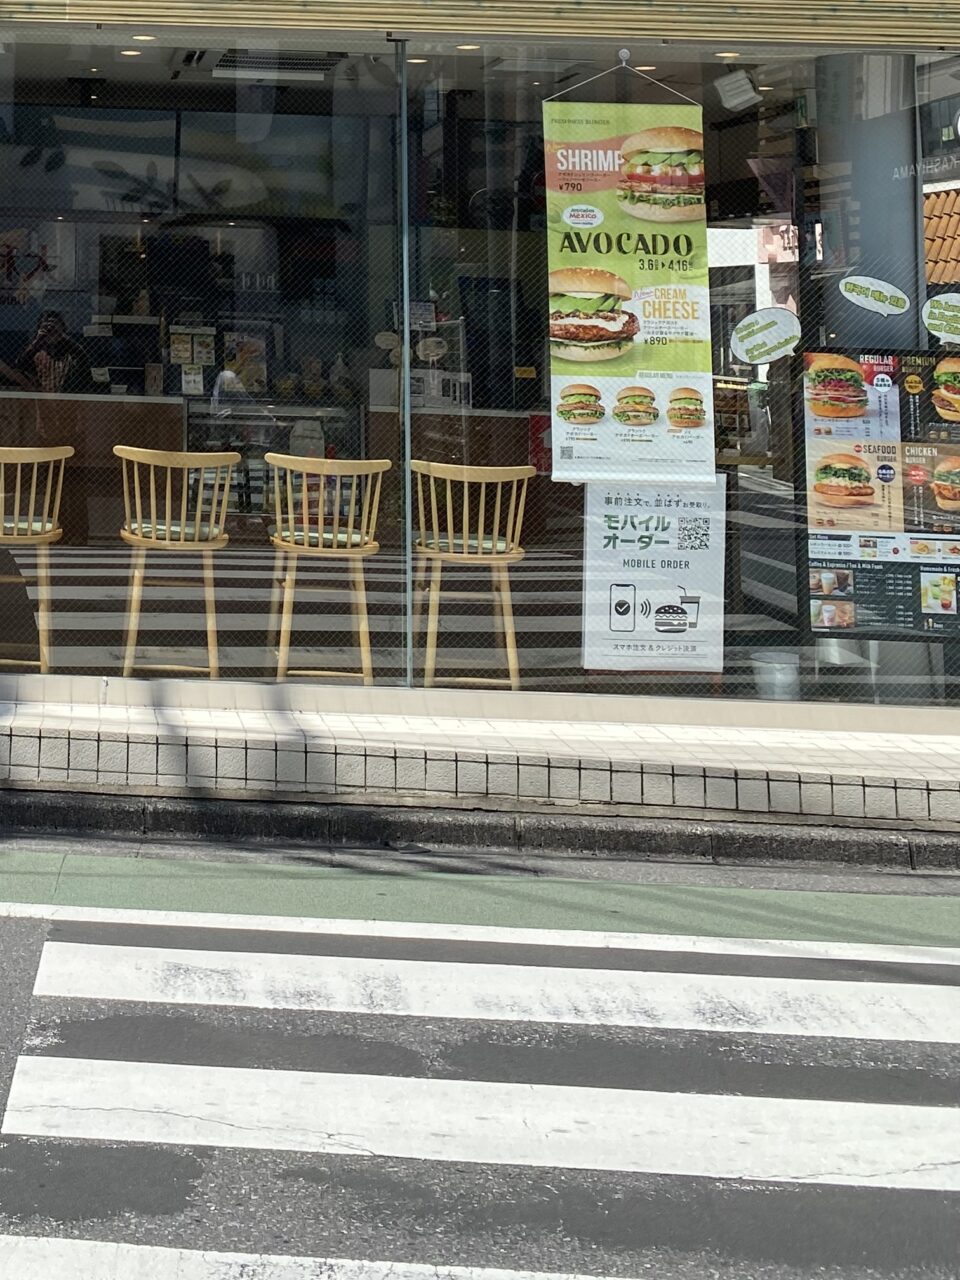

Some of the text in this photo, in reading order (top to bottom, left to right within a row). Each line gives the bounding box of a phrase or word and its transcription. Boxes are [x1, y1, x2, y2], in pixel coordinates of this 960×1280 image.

[556, 149, 625, 171] SHRIMP
[558, 182, 583, 192] ¥790
[559, 231, 694, 257] AVOCADO
[654, 288, 687, 300] CREAM
[642, 300, 700, 320] CHEESE
[644, 336, 668, 346] ¥890
[859, 354, 894, 365] REGULAR
[901, 356, 936, 367] PREMIUM
[863, 444, 897, 455] SEAFOOD
[905, 446, 938, 457] CHICKEN
[603, 514, 671, 532] モバイル
[603, 534, 670, 550] オーダー
[622, 558, 690, 570] MOBILE ORDER
